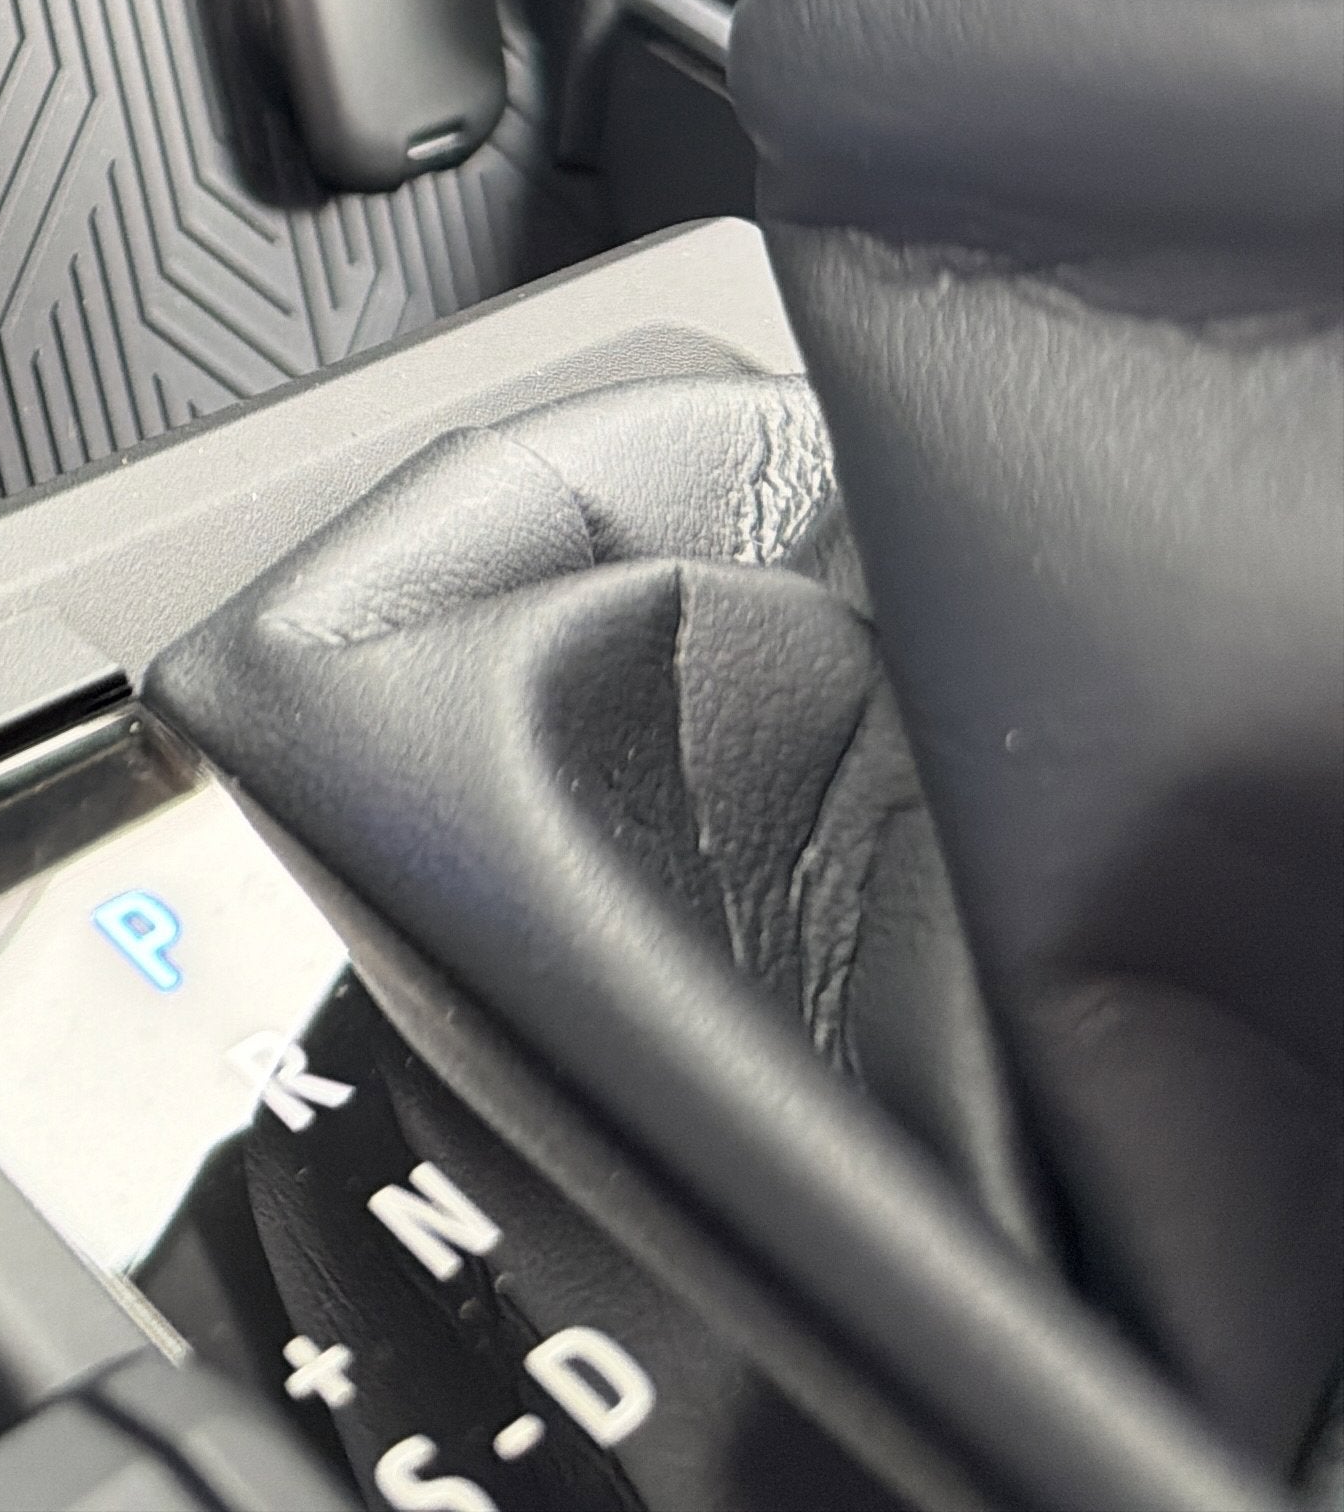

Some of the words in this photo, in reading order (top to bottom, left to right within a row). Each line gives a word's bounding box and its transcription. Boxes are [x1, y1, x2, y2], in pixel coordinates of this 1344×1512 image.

[93, 889, 183, 992] P
[225, 1029, 357, 1133] R
[367, 1160, 503, 1281] N
[523, 1325, 656, 1448] D
